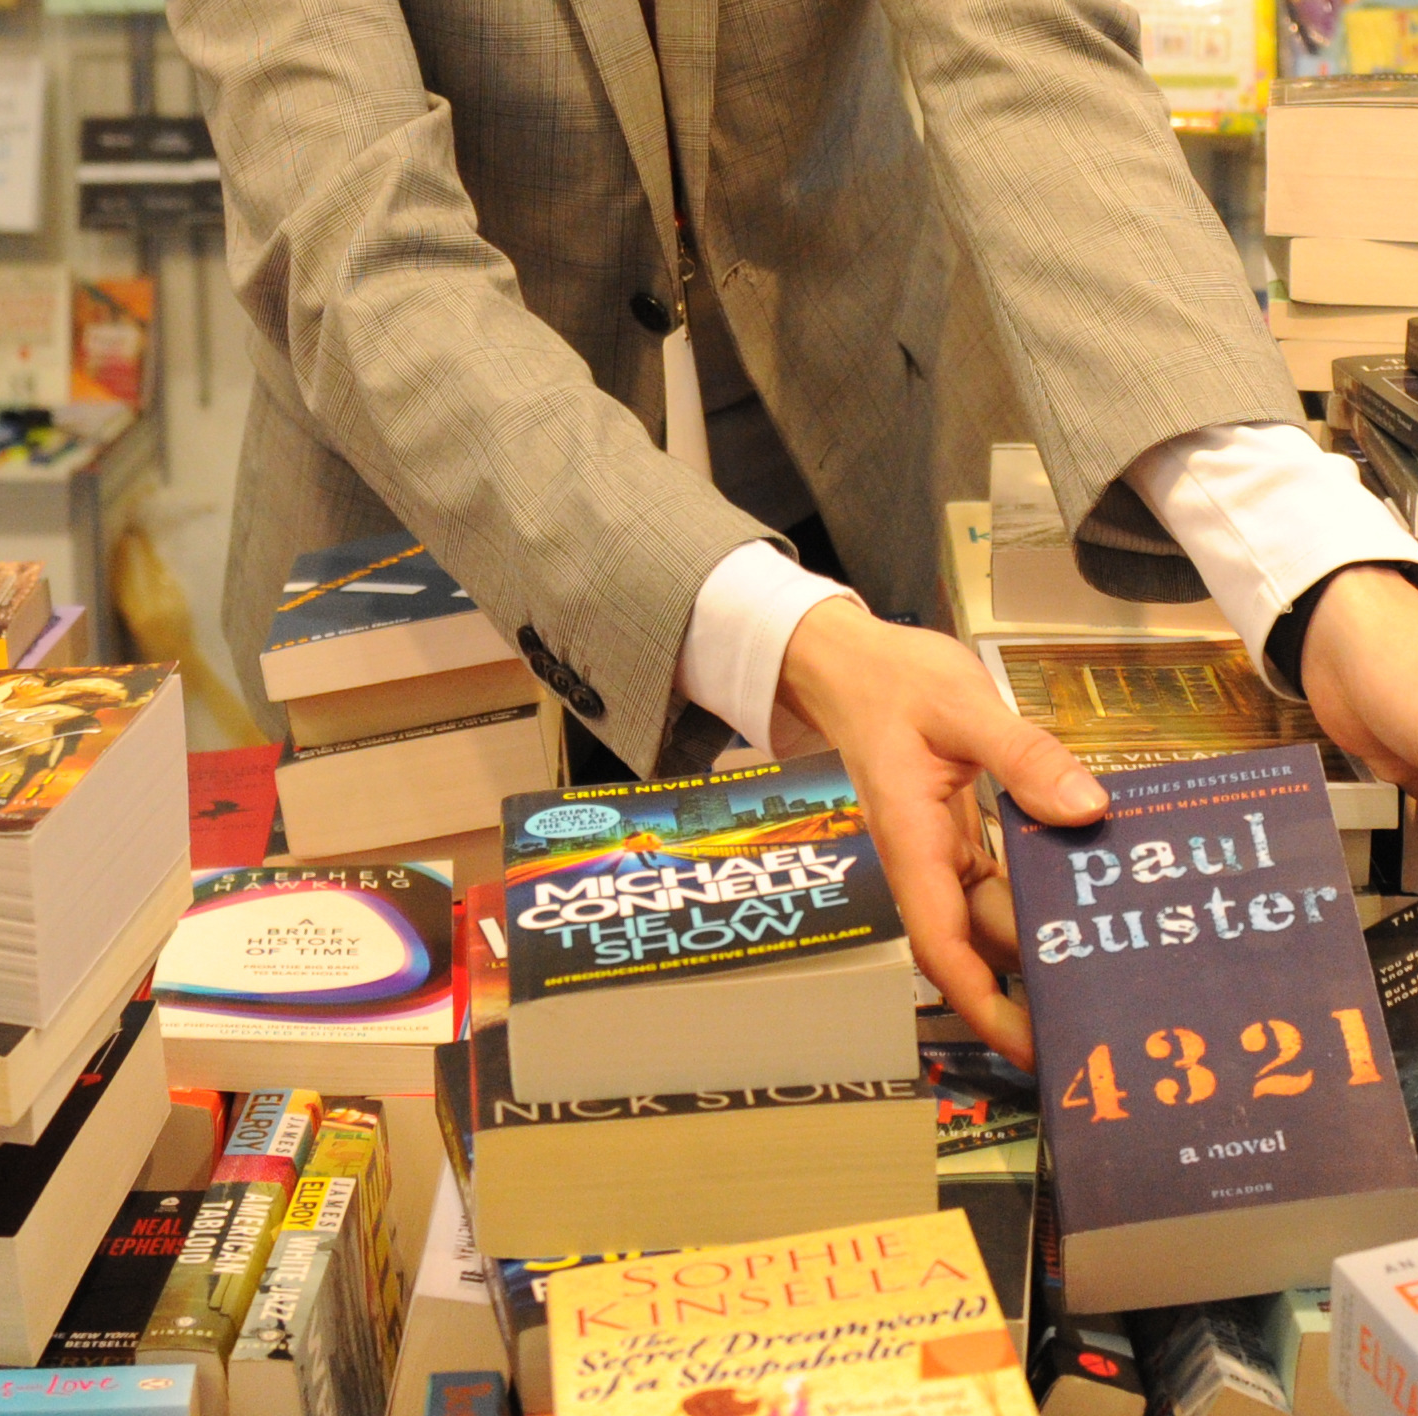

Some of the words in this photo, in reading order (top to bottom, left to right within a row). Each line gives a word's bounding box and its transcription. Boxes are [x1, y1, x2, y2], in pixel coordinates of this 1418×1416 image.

[561, 786, 631, 801] CRIME
[634, 778, 706, 795] NEVER
[709, 764, 782, 785] SLEEPS
[1116, 807, 1144, 820] FOR
[1146, 801, 1175, 817] THE
[1175, 796, 1210, 812] MAN
[1211, 790, 1268, 806] BOOKER
[1269, 783, 1312, 799] PRIZE
[1126, 780, 1183, 801] TIMES
[1185, 764, 1295, 791] BESTSELLER
[221, 868, 410, 883] STEPHEN
[534, 844, 838, 906] MICHAEL
[1066, 811, 1278, 908] paul
[213, 879, 412, 893] HAWKING
[516, 855, 859, 933] CONNELLY
[266, 926, 345, 936] BRIEF
[544, 911, 672, 950] THE
[690, 883, 851, 931] LATE
[594, 910, 806, 966] SHOW
[1035, 884, 1340, 965] auster
[245, 946, 289, 957] OF
[294, 946, 360, 957] TIME
[246, 936, 362, 948] HISTORY
[543, 961, 658, 988] INTRODUCING
[658, 947, 745, 972] DETECTIVE
[799, 924, 873, 948] BALLARD
[231, 1092, 287, 1153] ELLROY
[492, 1092, 667, 1125] NICK
[694, 1079, 917, 1111] STONE
[275, 1115, 306, 1157] JAMES
[936, 1129, 1007, 1141] AUTHOR
[1178, 1143, 1200, 1165] a
[1206, 1129, 1288, 1161] novel
[287, 1179, 326, 1228] ELLROY
[318, 1180, 351, 1229] JAMES
[1210, 1182, 1275, 1200] PICADOR
[132, 1218, 181, 1235] NEAL
[178, 1199, 234, 1265] TABLOID
[212, 1192, 274, 1275] AMERICAN
[285, 1235, 322, 1283] WHITE
[621, 1229, 911, 1300] SOPHIE
[1384, 1256, 1418, 1274] AN
[259, 1284, 302, 1321] JAZZ
[573, 1257, 973, 1339] KINSELLA
[577, 1335, 720, 1379] Secret
[725, 1295, 990, 1357] Dreamworld
[620, 1330, 686, 1353] The
[577, 1371, 619, 1404] of
[679, 1337, 919, 1392] Shopaholic
